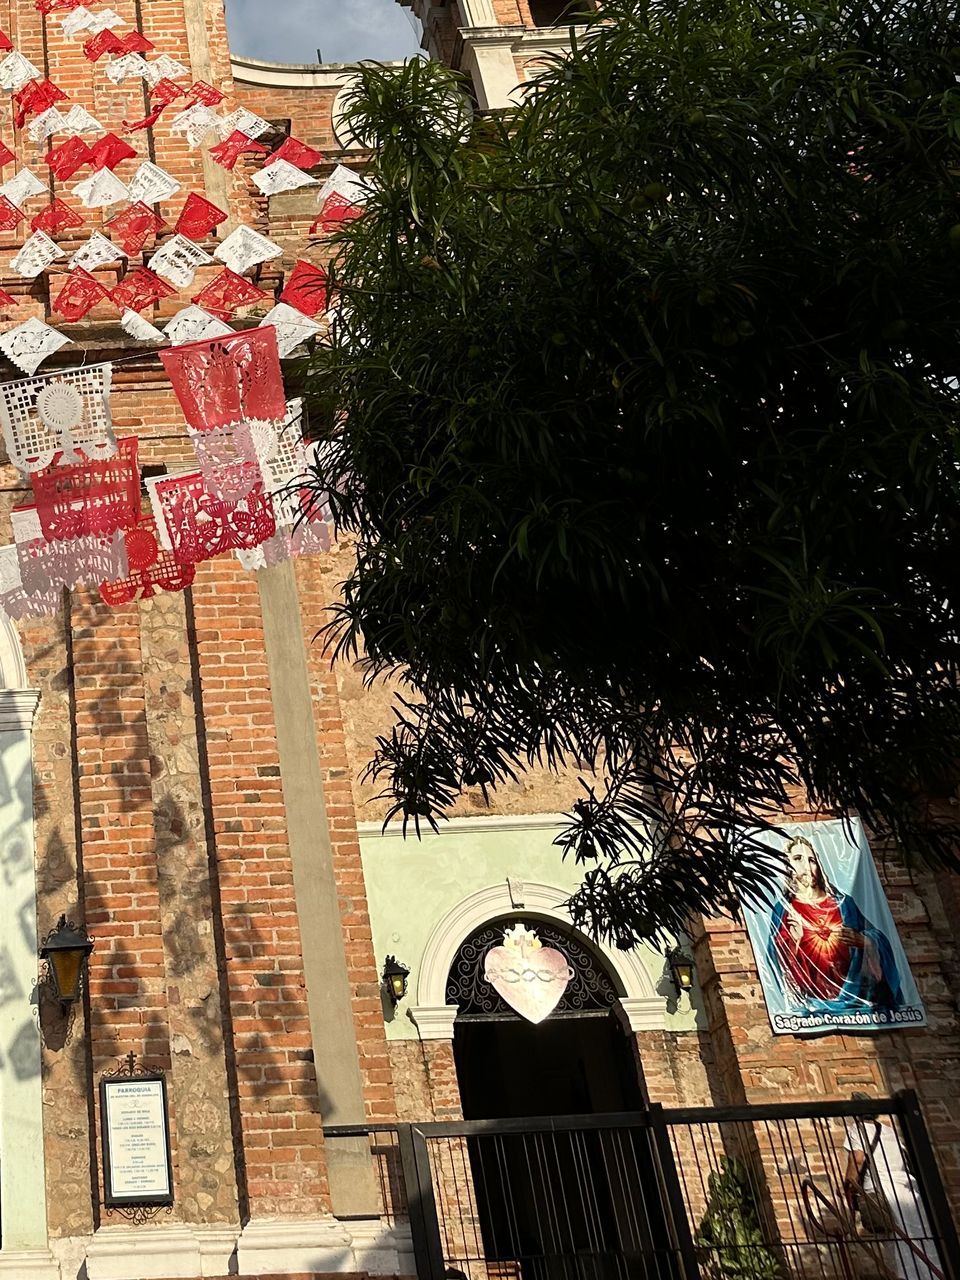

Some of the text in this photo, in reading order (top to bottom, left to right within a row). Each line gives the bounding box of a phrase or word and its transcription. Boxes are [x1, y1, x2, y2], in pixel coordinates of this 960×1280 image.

[775, 1008, 922, 1030] Sagrado Corazón de Jesús
